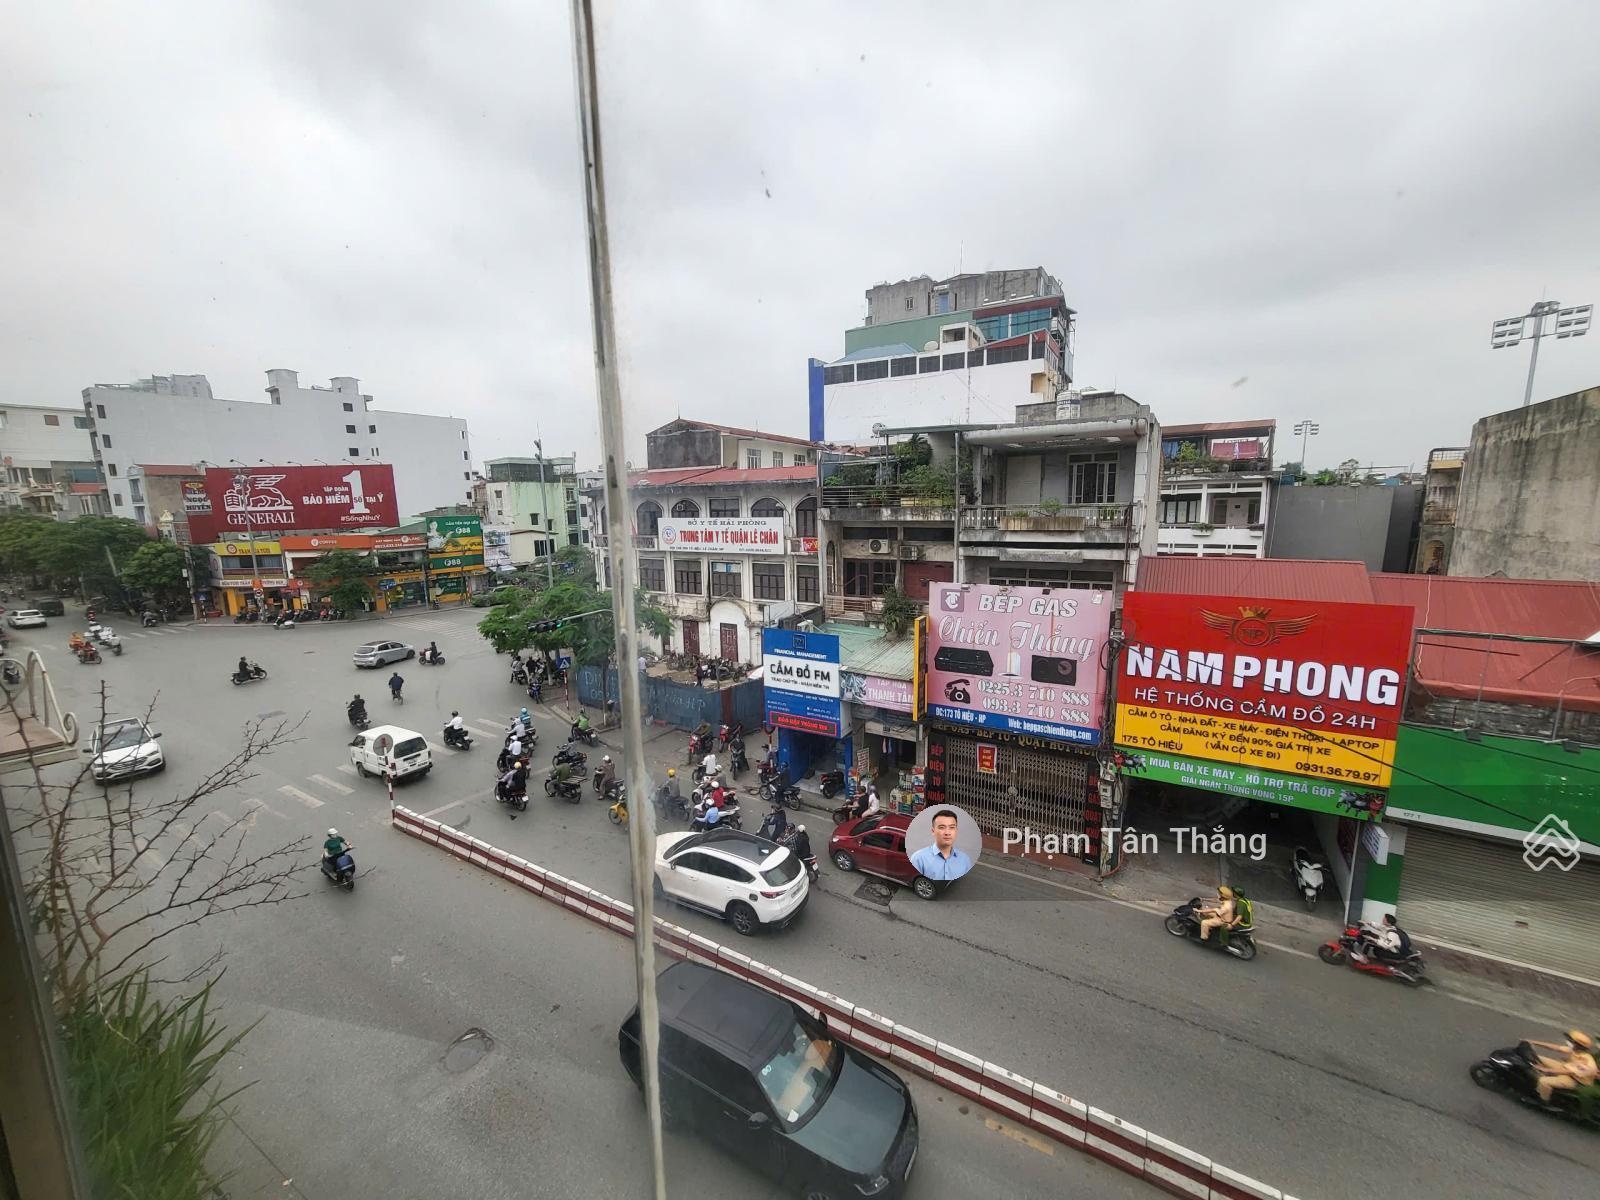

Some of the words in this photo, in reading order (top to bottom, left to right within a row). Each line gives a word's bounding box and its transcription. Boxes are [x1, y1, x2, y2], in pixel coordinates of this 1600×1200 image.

[302, 493, 323, 504] BẢO
[325, 492, 350, 504] HIỂM
[342, 470, 370, 514] 1
[227, 512, 296, 525] GENERALI
[680, 530, 699, 543] TRUNG
[700, 528, 714, 543] TÂM
[716, 531, 720, 543] Y
[722, 527, 729, 544] TẾ
[731, 528, 748, 546] QUẬN
[750, 528, 758, 544] LÊ
[760, 528, 778, 544] CHÂN
[978, 589, 1023, 614] BẾP
[1029, 596, 1078, 618] GAS
[938, 615, 1000, 647] Chiến
[1009, 620, 1095, 662] Thắng
[774, 648, 795, 656] FINANCIAL
[796, 652, 827, 660] MANAGEMENT
[814, 670, 831, 682] FM
[1126, 645, 1224, 686] NAM
[1232, 655, 1400, 706] PHONG
[868, 688, 895, 702] THANH
[978, 679, 1023, 698] 0225.3
[1029, 686, 1056, 702] 710
[1061, 690, 1090, 706] 888
[954, 708, 961, 720] TÔ
[962, 710, 974, 723] HIỆU
[978, 714, 986, 723] HP
[982, 696, 1021, 714] 093.3
[1028, 703, 1055, 719] 710
[1060, 708, 1090, 725] 888
[1134, 686, 1159, 704] HỆ
[1164, 691, 1234, 712] THỐNG
[1240, 698, 1286, 719] CẦM
[1292, 704, 1325, 723] ĐỒ
[1331, 712, 1376, 730] 24H
[1008, 718, 1022, 729] Web:
[1128, 707, 1148, 719] CẦM
[1150, 710, 1157, 719] Ô
[1160, 709, 1172, 720] TÔ
[1179, 716, 1197, 725] NHÀ
[1200, 718, 1218, 728] ĐẤT
[1223, 722, 1236, 730] XE
[1240, 723, 1259, 733] MÁY
[1265, 727, 1289, 738] ĐIỆN
[1333, 738, 1380, 750] LAPTOP
[1122, 735, 1138, 743] 175
[1141, 736, 1156, 746] TÔ
[1159, 739, 1183, 751] HIỆU
[1160, 724, 1180, 734] CẦM
[1183, 727, 1209, 738] ĐĂNG
[1229, 732, 1250, 744] ĐẾN
[1252, 738, 1273, 748] 90%
[1276, 741, 1293, 750] GIÁ
[1315, 747, 1331, 756] XE
[1231, 745, 1246, 754] CÓ
[1250, 748, 1263, 756] XE
[1150, 758, 1170, 768] MUA
[1196, 765, 1209, 776] XE
[1296, 762, 1380, 782] 0931.36.79.97
[1224, 784, 1250, 794] TRONG
[1278, 794, 1294, 803] 15P
